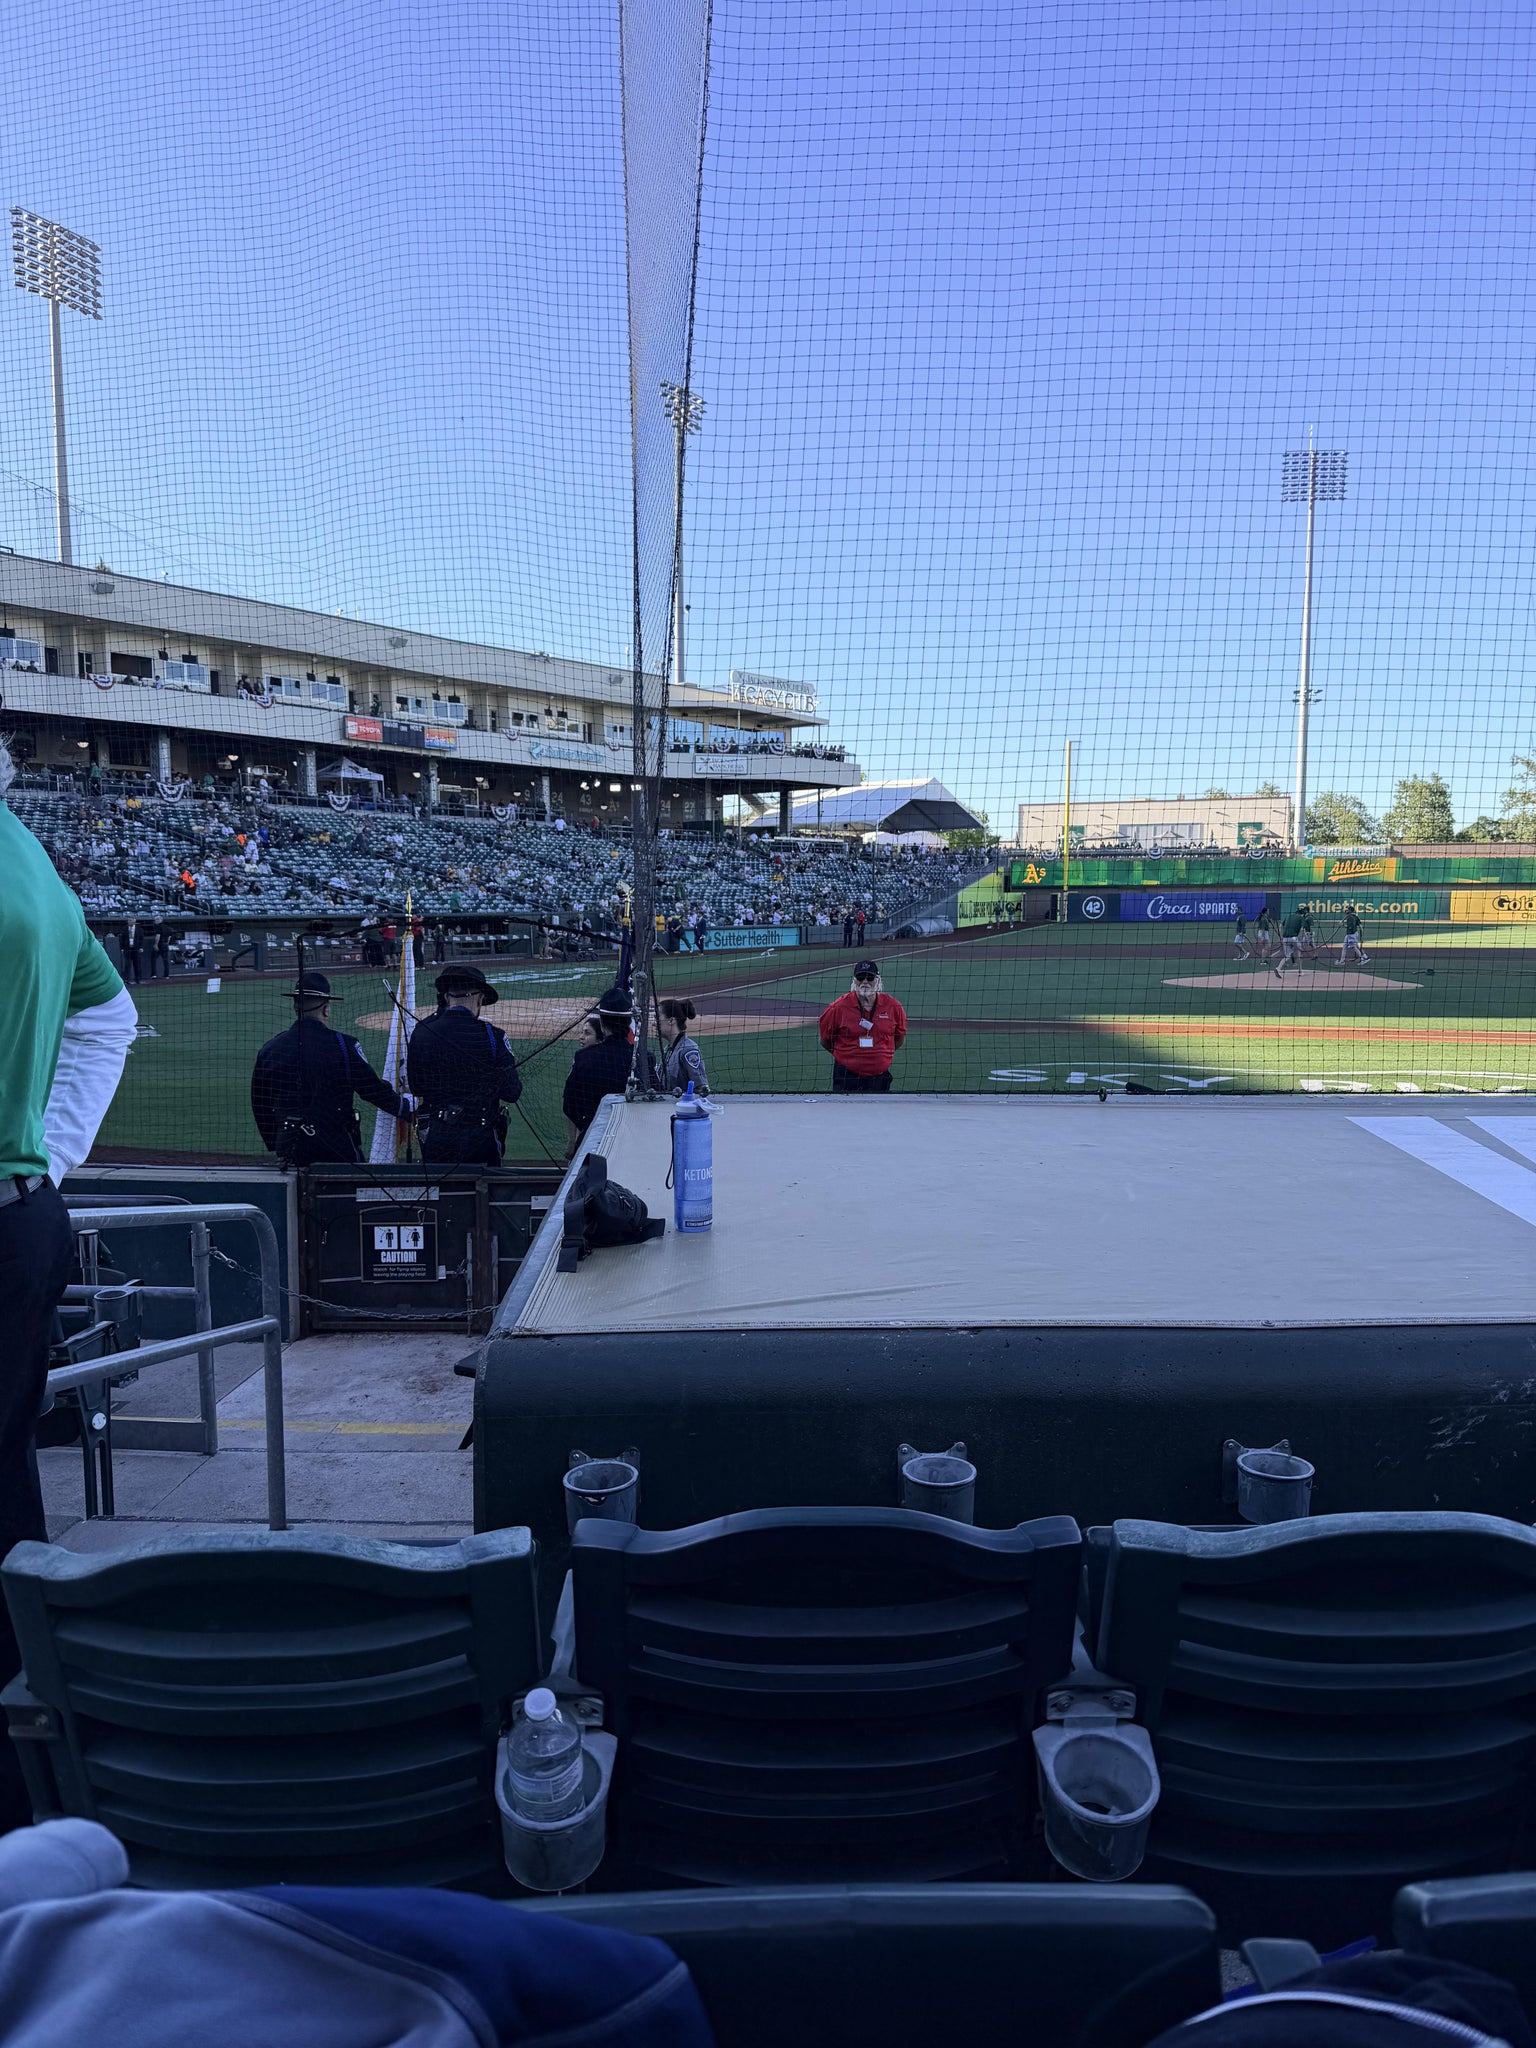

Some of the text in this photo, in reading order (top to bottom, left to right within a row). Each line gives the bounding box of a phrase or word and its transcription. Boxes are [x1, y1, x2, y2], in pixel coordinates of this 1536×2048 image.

[731, 683, 817, 713] LEGACY CLUB
[359, 725, 381, 734] TOYOTA
[552, 791, 564, 804] 24
[580, 793, 592, 806] 43
[660, 799, 671, 811] 34
[684, 801, 695, 813] 27
[1318, 847, 1386, 857] Sutter Health
[1022, 863, 1047, 884] A's
[1328, 859, 1382, 878] Athletics
[1085, 901, 1100, 914] 42
[1146, 895, 1238, 919] Circa SPORTS
[1298, 899, 1418, 914] athletics.com
[713, 930, 780, 948] Sutter Health
[988, 1069, 1235, 1088] SKY
[380, 1251, 417, 1263] CAUTION!
